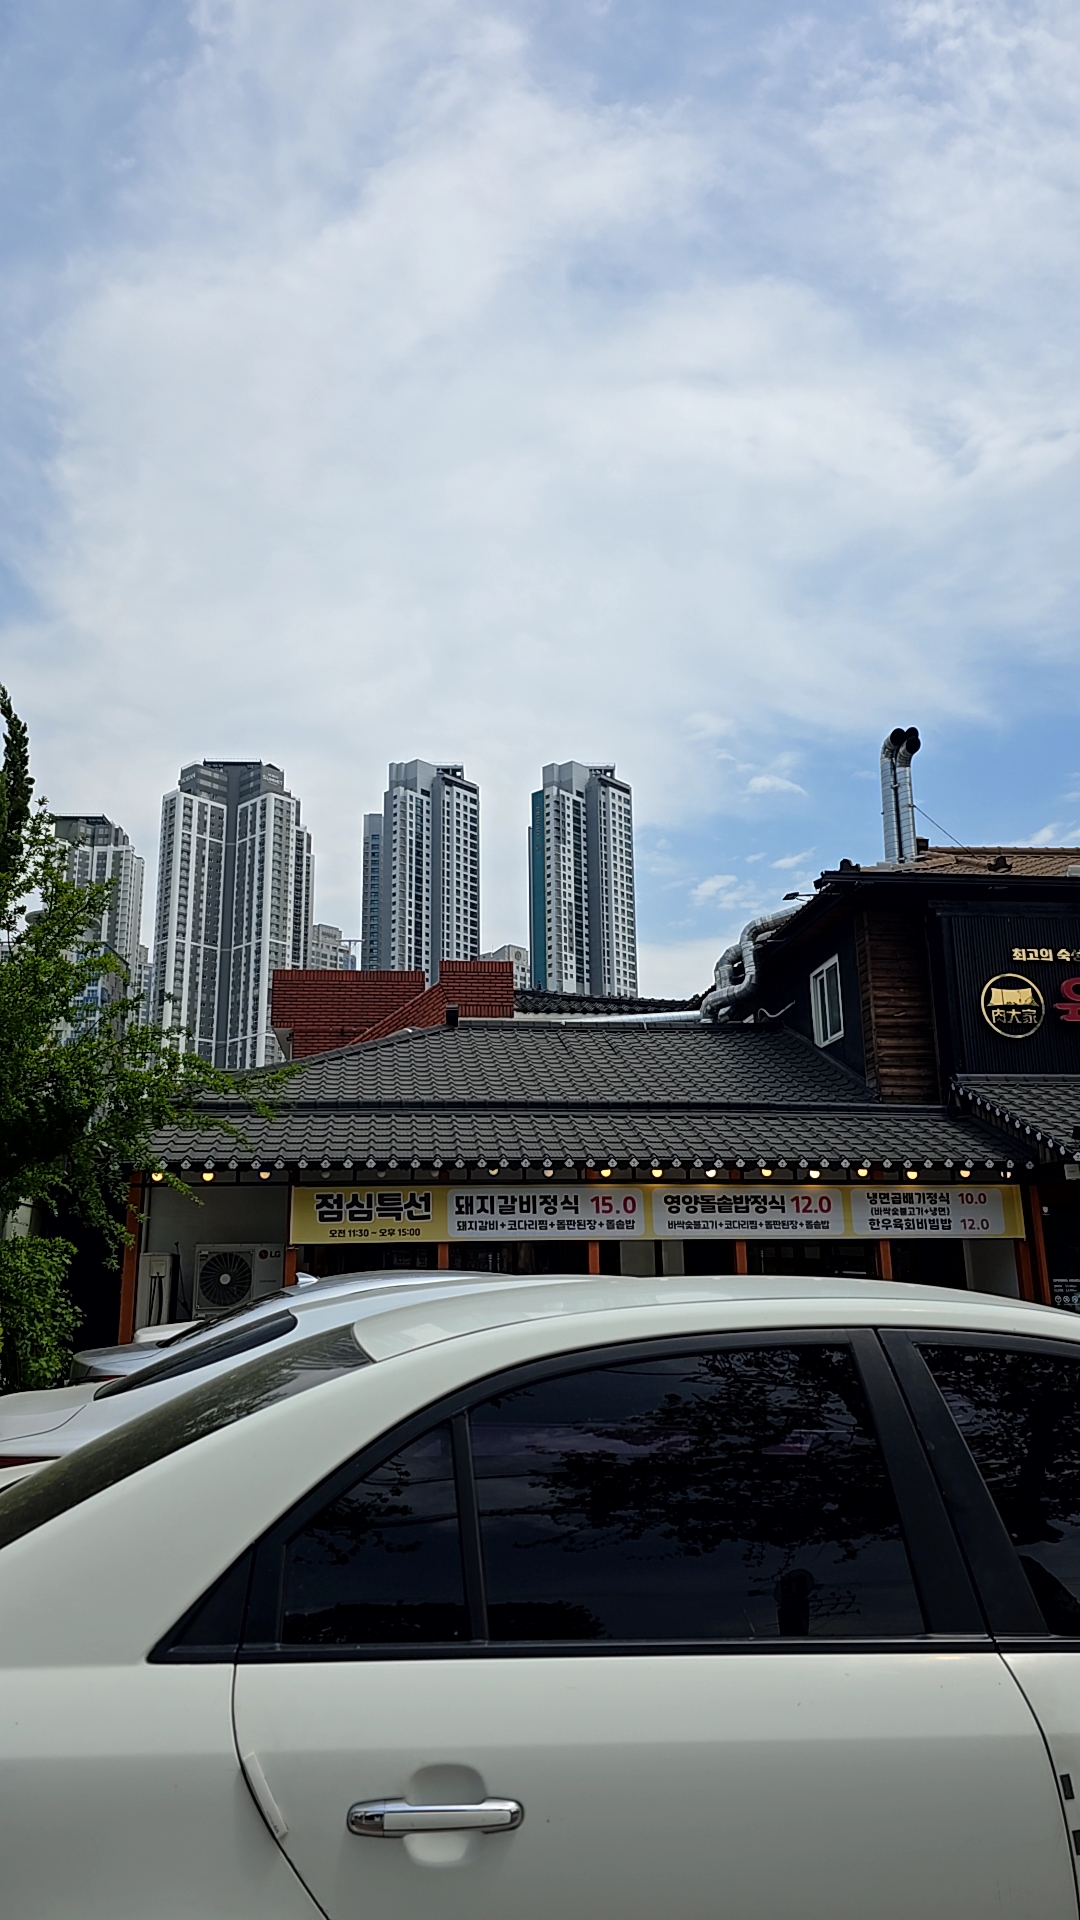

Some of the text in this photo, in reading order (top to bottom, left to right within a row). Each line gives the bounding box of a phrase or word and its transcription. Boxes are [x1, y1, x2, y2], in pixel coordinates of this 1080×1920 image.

[1012, 948, 1054, 961] 최고의
[454, 1194, 637, 1215] 돼지갈비정식 15.0
[663, 1194, 832, 1214] 영양돌솥밥정식 12.0
[957, 1192, 987, 1204] 10.0
[315, 1192, 432, 1222] 점심특선
[868, 1218, 990, 1231] 한우육회비빔밥 12.0
[329, 1229, 346, 1238] 오전
[347, 1229, 370, 1238] 11:30
[378, 1228, 396, 1237] 오후
[397, 1228, 421, 1237] 15:00
